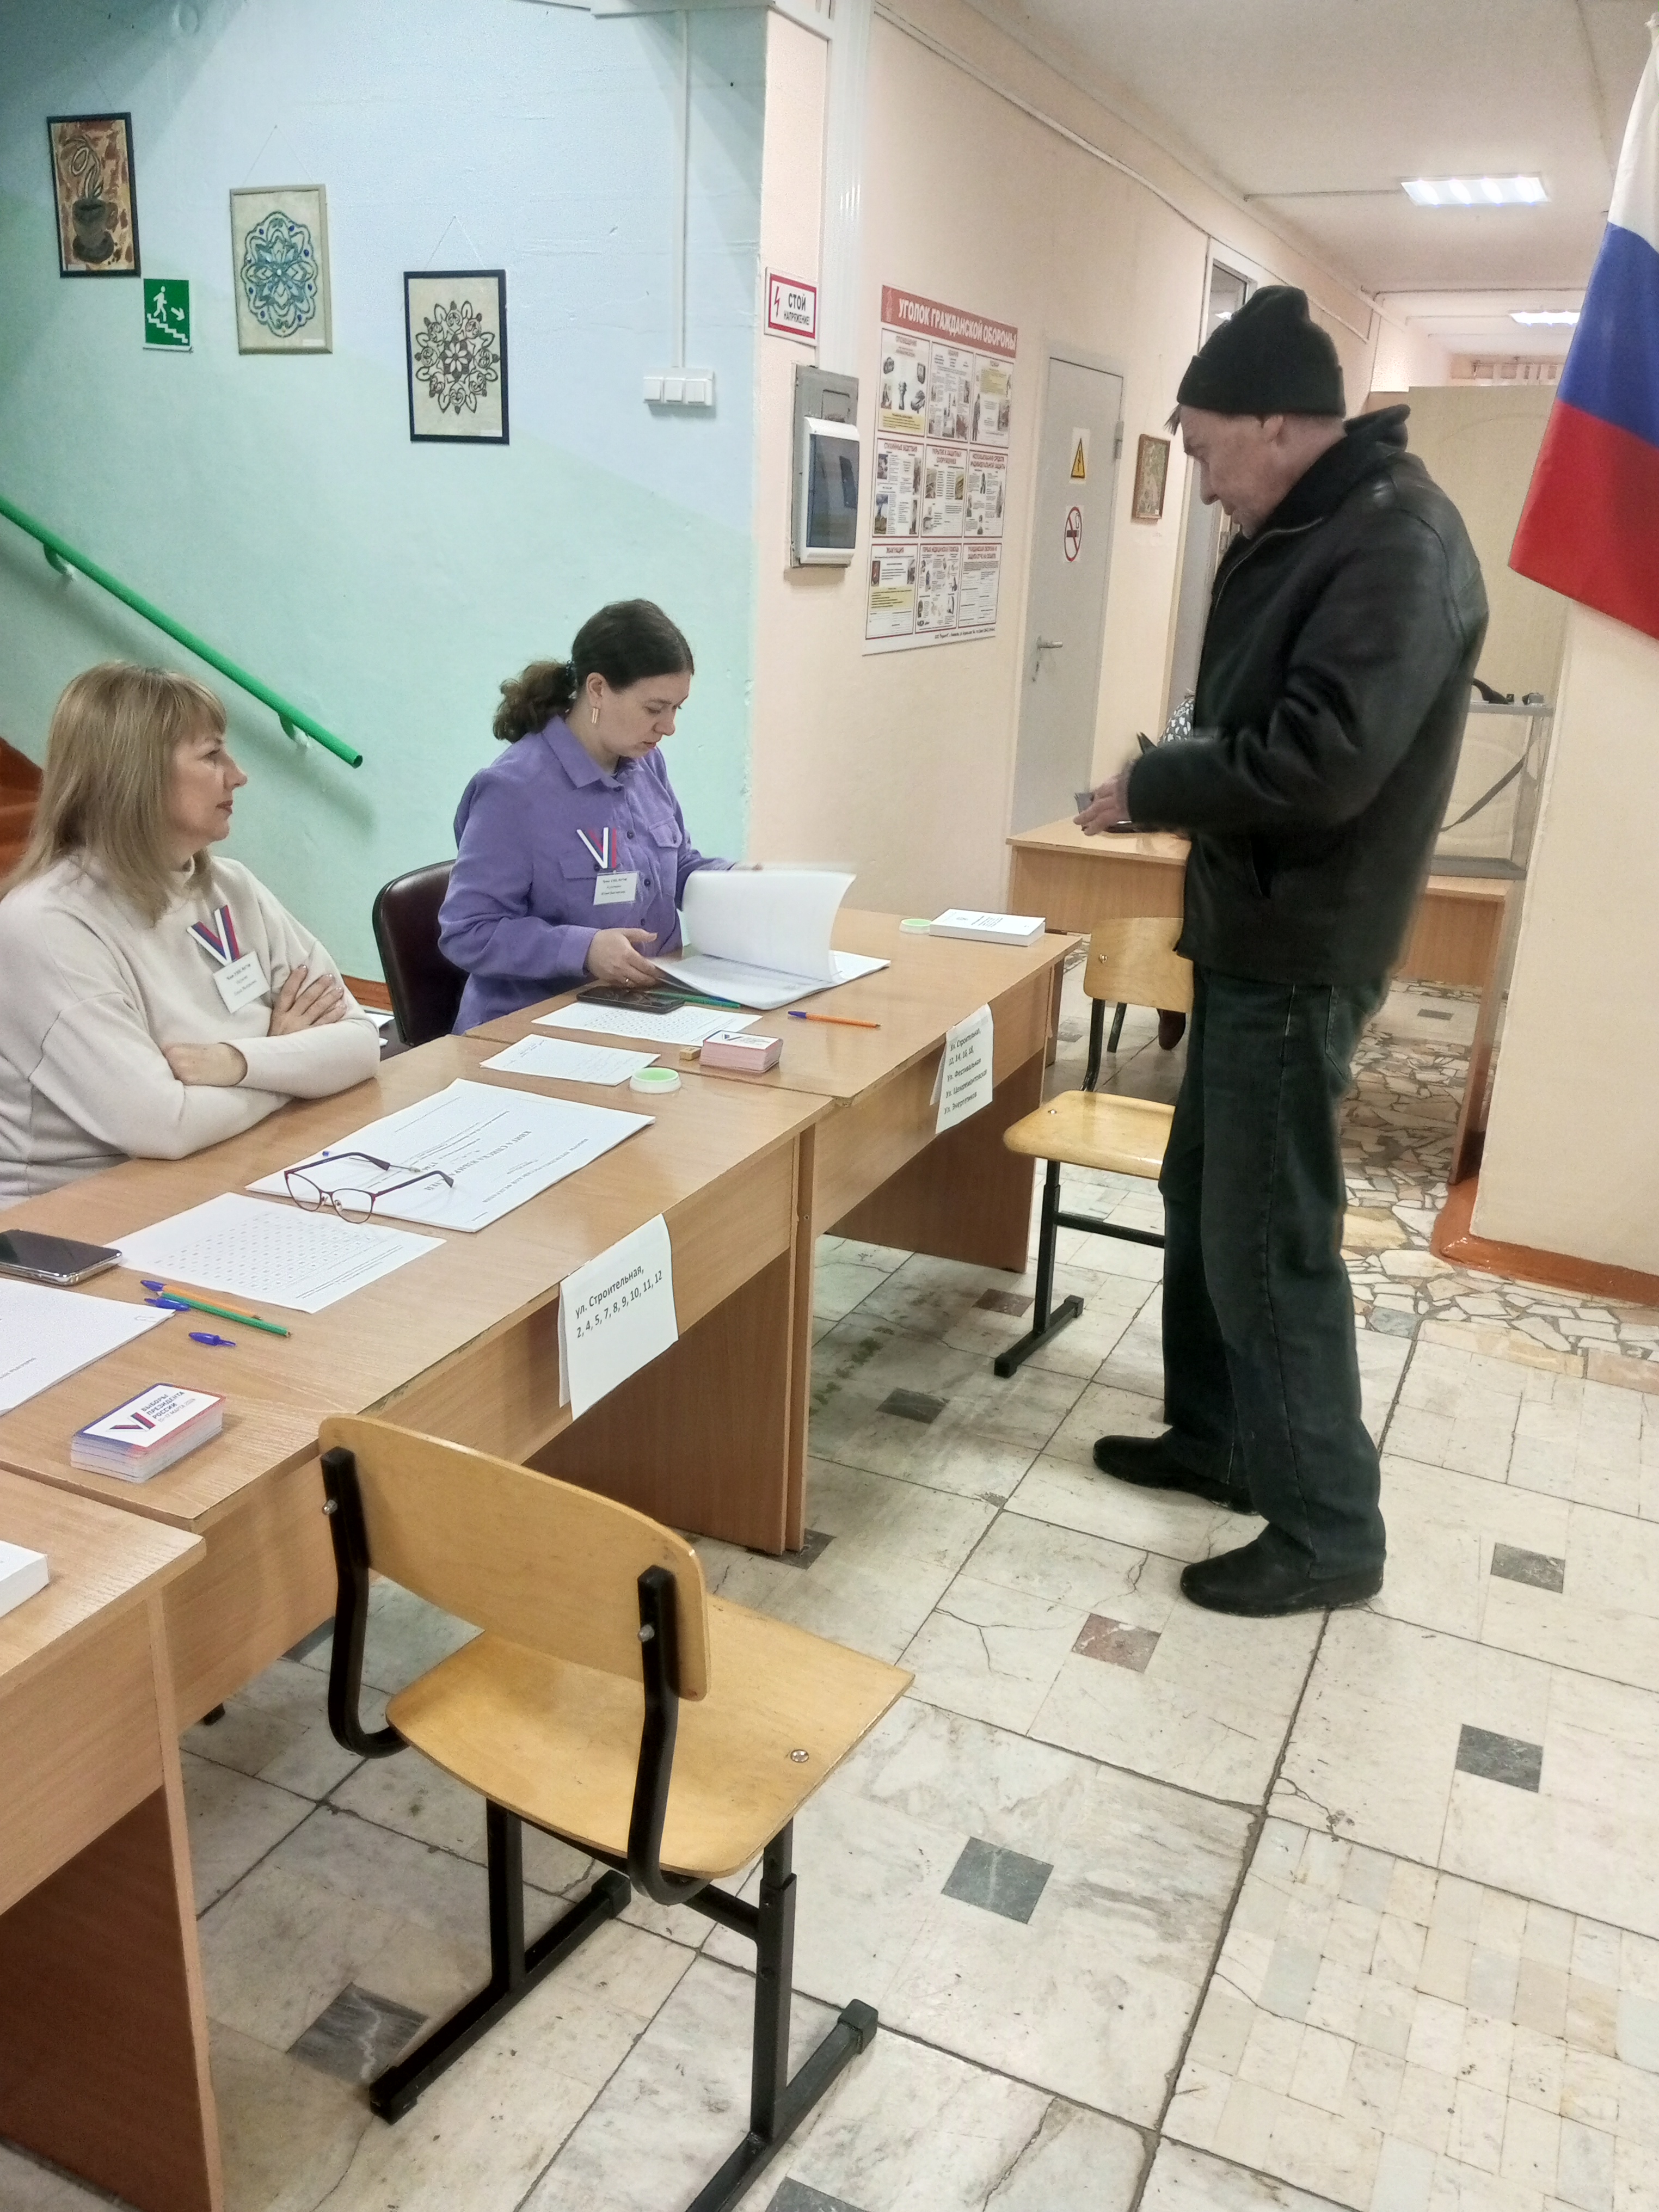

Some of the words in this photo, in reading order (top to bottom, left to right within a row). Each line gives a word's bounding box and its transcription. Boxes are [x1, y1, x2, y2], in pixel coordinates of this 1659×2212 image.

[788, 293, 806, 311] СТОЙ
[899, 298, 930, 326] УГОЛОК
[930, 308, 984, 341] ГРАЖДАНСКОЙ
[983, 324, 1017, 351] ОБОРОНЫ
[575, 1306, 587, 1319] ул.
[589, 1265, 644, 1307] Строительная,
[577, 1327, 584, 1338] 2,
[586, 1320, 593, 1331] 4,
[595, 1314, 603, 1326] 5,
[604, 1307, 611, 1319] 7,
[613, 1302, 620, 1313] 8,
[622, 1295, 629, 1307] 9,
[630, 1287, 642, 1301] 10,
[643, 1279, 654, 1293] 11,
[655, 1270, 663, 1285] 12
[141, 1394, 169, 1412] ВЫБОРЫ
[146, 1391, 185, 1416] ПРЕЗИДЕНТА
[152, 1403, 177, 1420] РОССИИ
